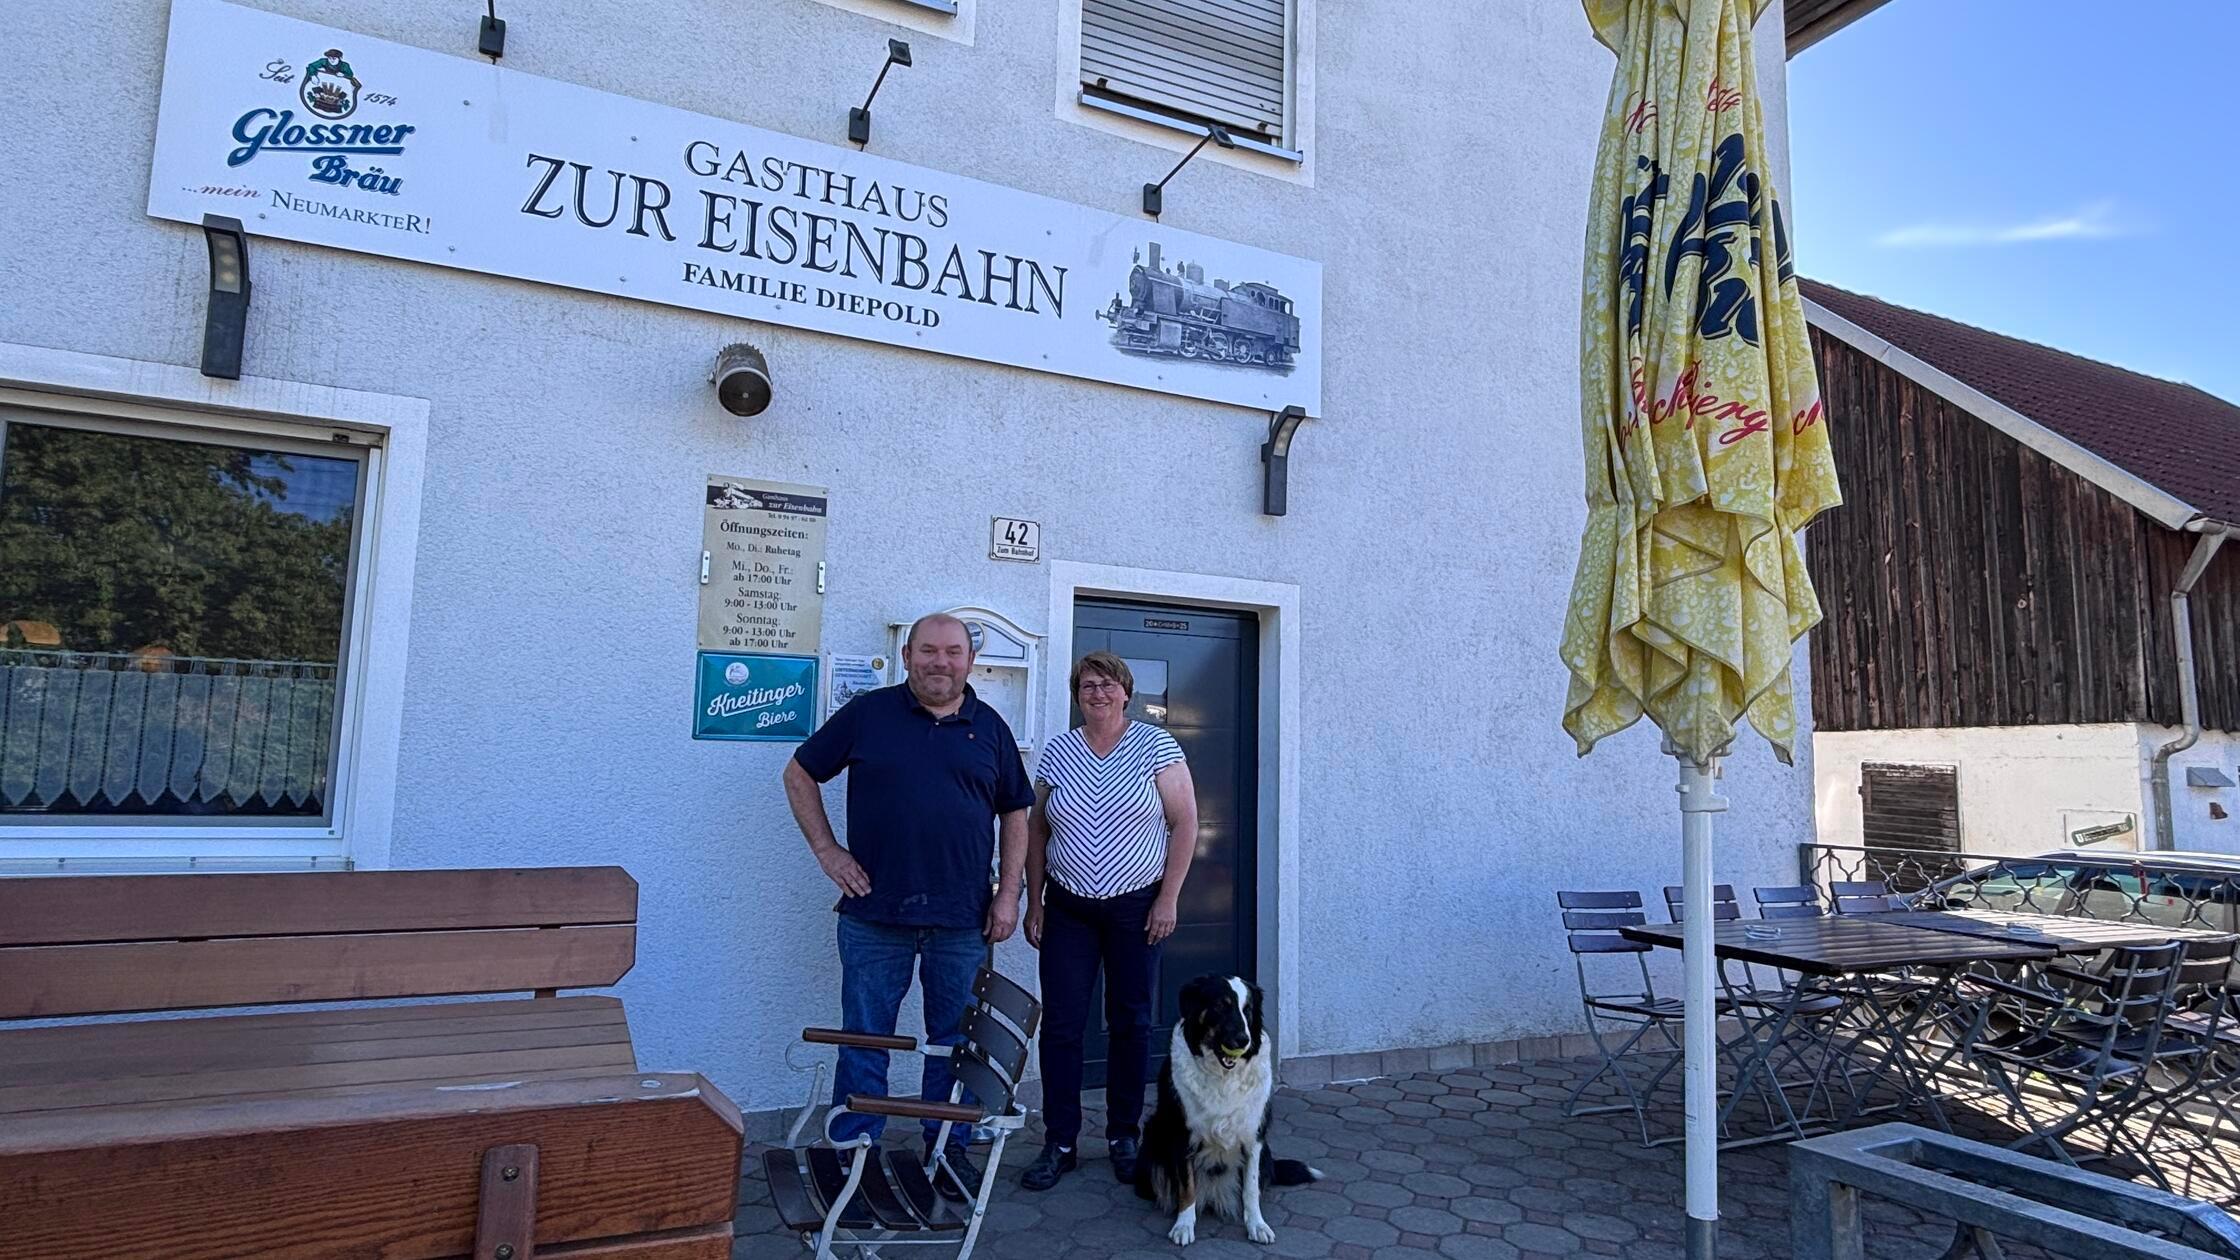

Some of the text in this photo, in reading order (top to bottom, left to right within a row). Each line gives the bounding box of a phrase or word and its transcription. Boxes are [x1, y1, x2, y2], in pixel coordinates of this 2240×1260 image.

[259, 58, 295, 84] Seit
[363, 92, 398, 107] 1574
[227, 108, 416, 168] Glossner
[308, 155, 403, 196] Bräu
[684, 140, 949, 228] GASTHAUS
[521, 153, 1068, 319] ZUR EISENBAHN
[682, 263, 941, 328] FAMILIE DIEPOLD
[768, 502, 822, 514] zur Eisenbahn
[720, 519, 809, 539] Öffnungszeiten:
[1005, 521, 1028, 545] 42
[726, 541, 745, 552] Mo.,
[765, 545, 801, 558] Ruhetag
[732, 560, 751, 572] Mi.,
[754, 562, 775, 575] Do.,
[733, 573, 792, 585] ab 17:00 Uhr
[738, 586, 781, 601] Samstag:
[724, 598, 745, 608] 9:00
[753, 600, 778, 610] 13:00
[780, 602, 798, 611] Uhr
[736, 612, 780, 627] Sonntag:
[723, 625, 743, 635] 9:00
[752, 627, 776, 637] 13:00
[779, 629, 796, 638] Uhr
[729, 637, 789, 648] ab 17:00 Uhr
[707, 682, 805, 717] Kneitinger
[756, 710, 797, 728] Biere
